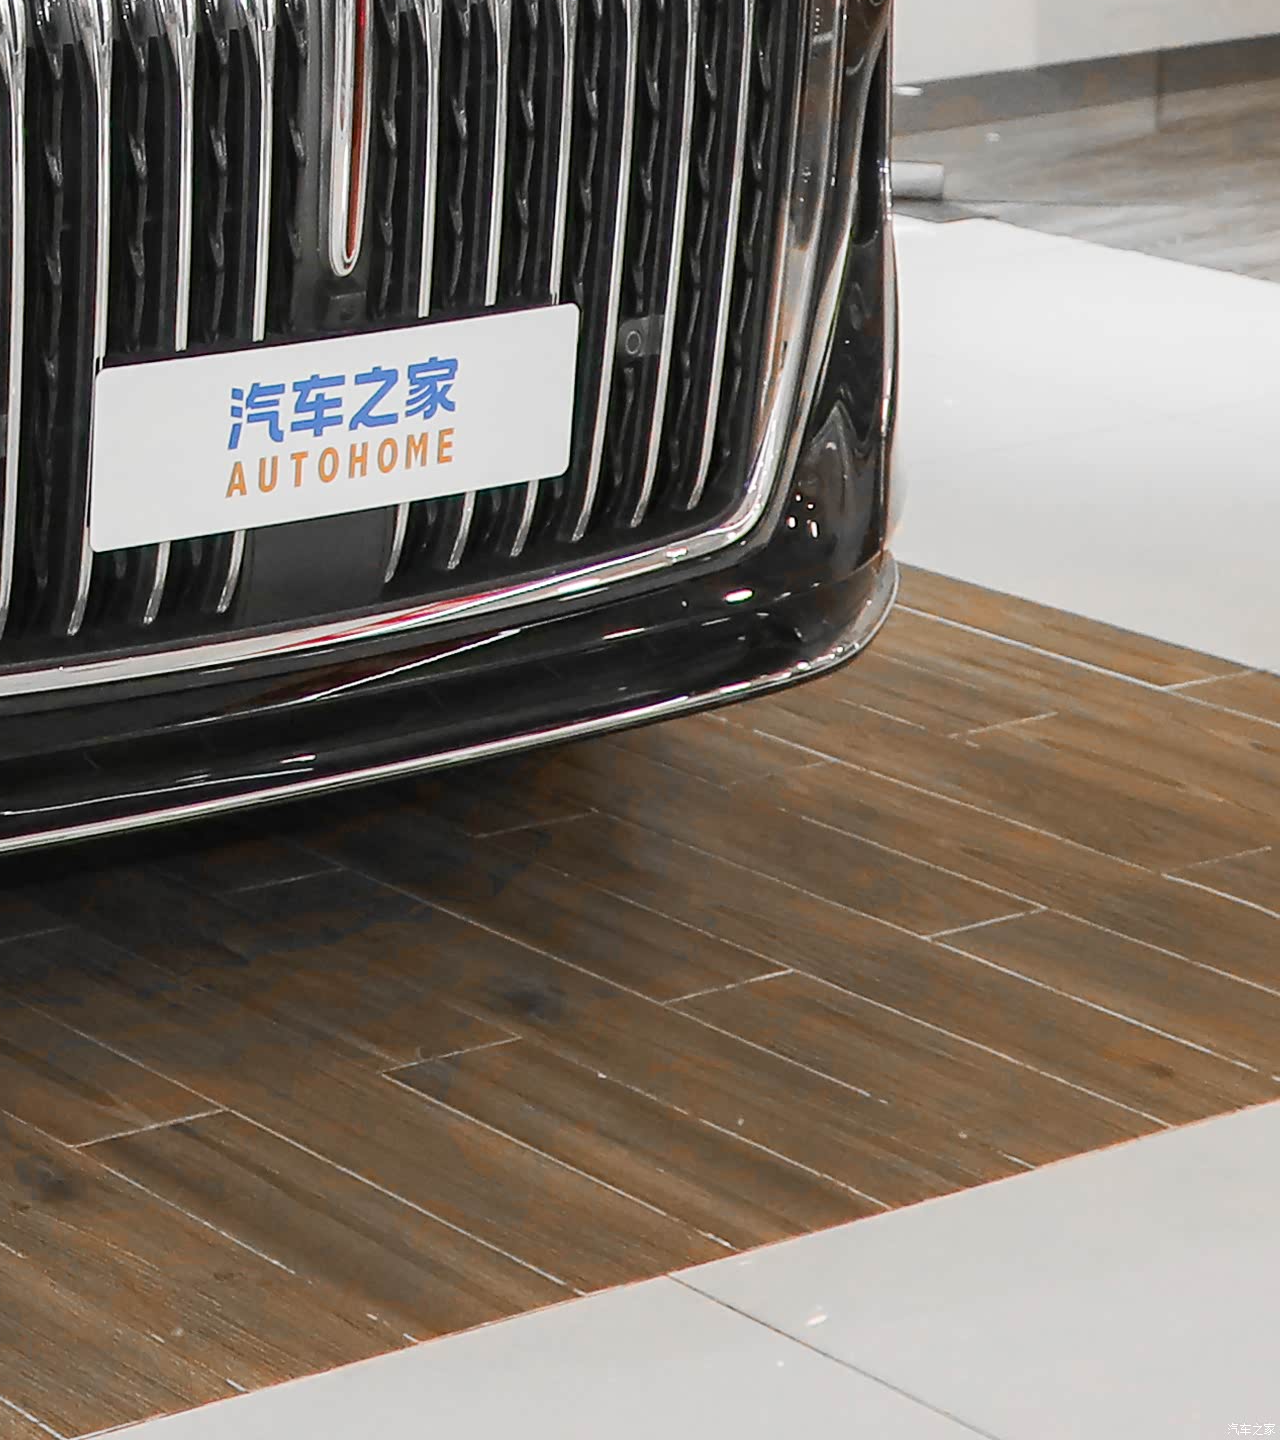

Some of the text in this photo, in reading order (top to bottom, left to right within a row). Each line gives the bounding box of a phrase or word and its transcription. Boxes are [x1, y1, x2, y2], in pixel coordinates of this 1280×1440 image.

[227, 356, 459, 450] 汽车之家
[226, 427, 456, 498] AUTOHOME
